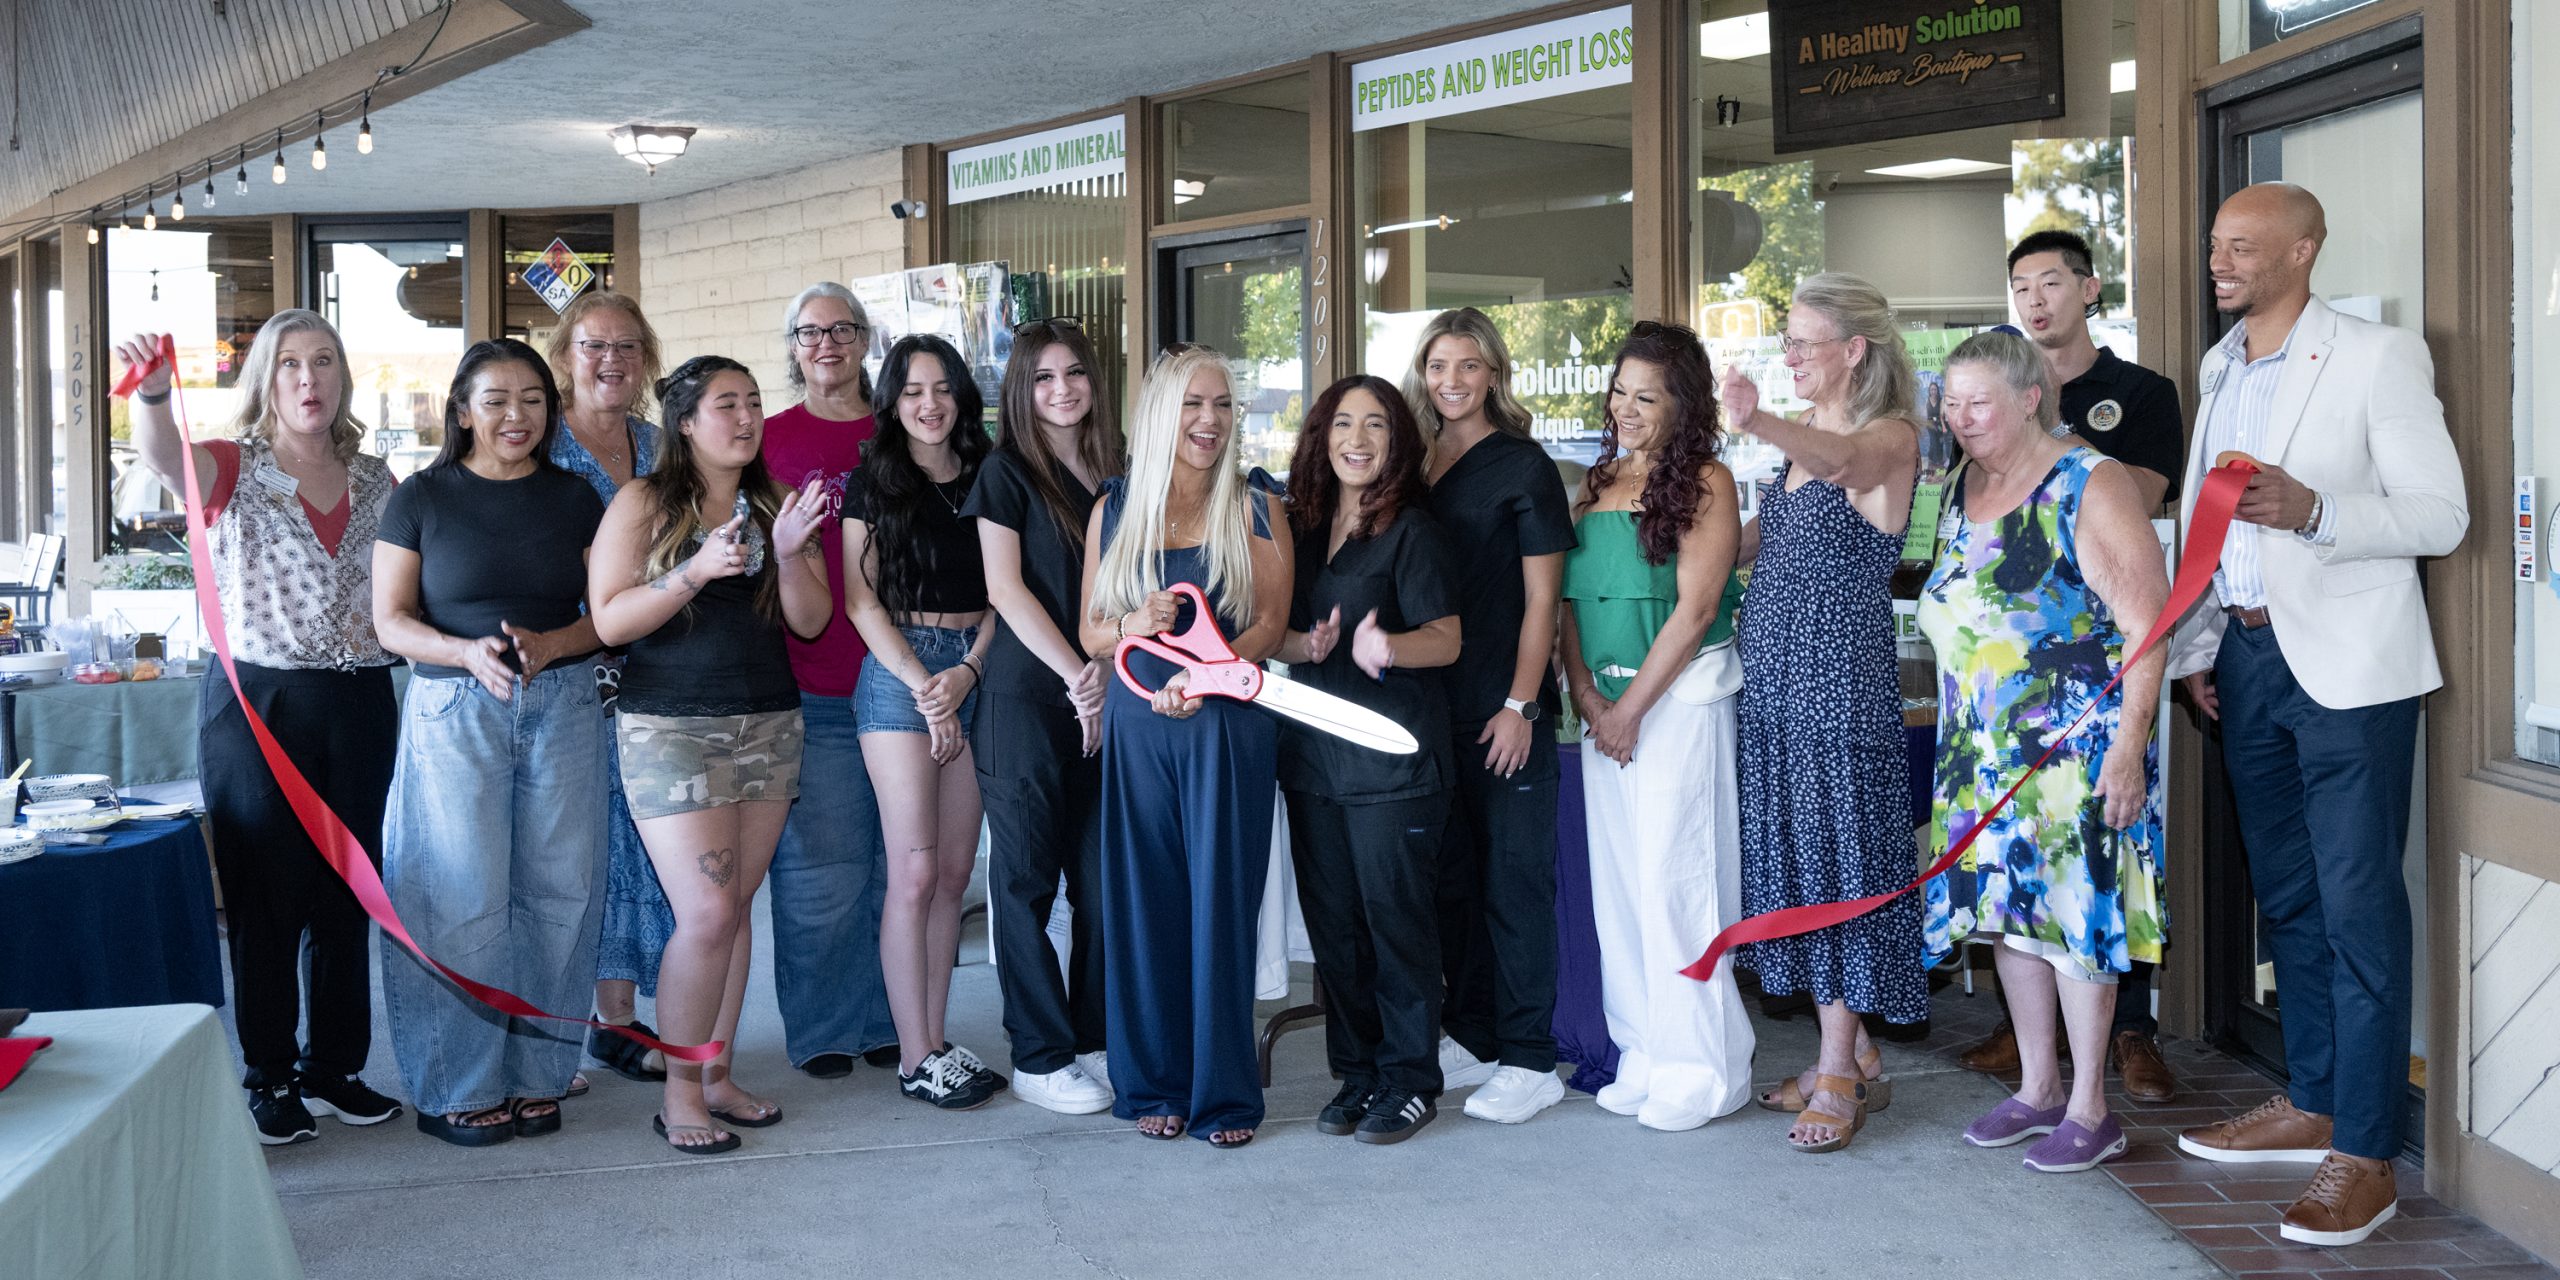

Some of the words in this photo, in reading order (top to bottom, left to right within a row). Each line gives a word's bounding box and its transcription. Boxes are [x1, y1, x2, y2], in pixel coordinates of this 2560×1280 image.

[1799, 36, 1815, 64] A
[1820, 23, 1910, 60] Healthy
[1915, 3, 2021, 44] Solution
[1358, 67, 1436, 115] PEPTIDES
[1442, 58, 1486, 98] AND
[1492, 39, 1573, 88] WEIGHT
[1579, 26, 1632, 72] LOSS
[1823, 63, 1904, 96] Wellness
[1903, 49, 1996, 87] Boutique
[952, 152, 1017, 190] VITAMINS
[1021, 145, 1051, 178] AND
[1056, 129, 1126, 170] MINERAL
[548, 287, 568, 300] SA
